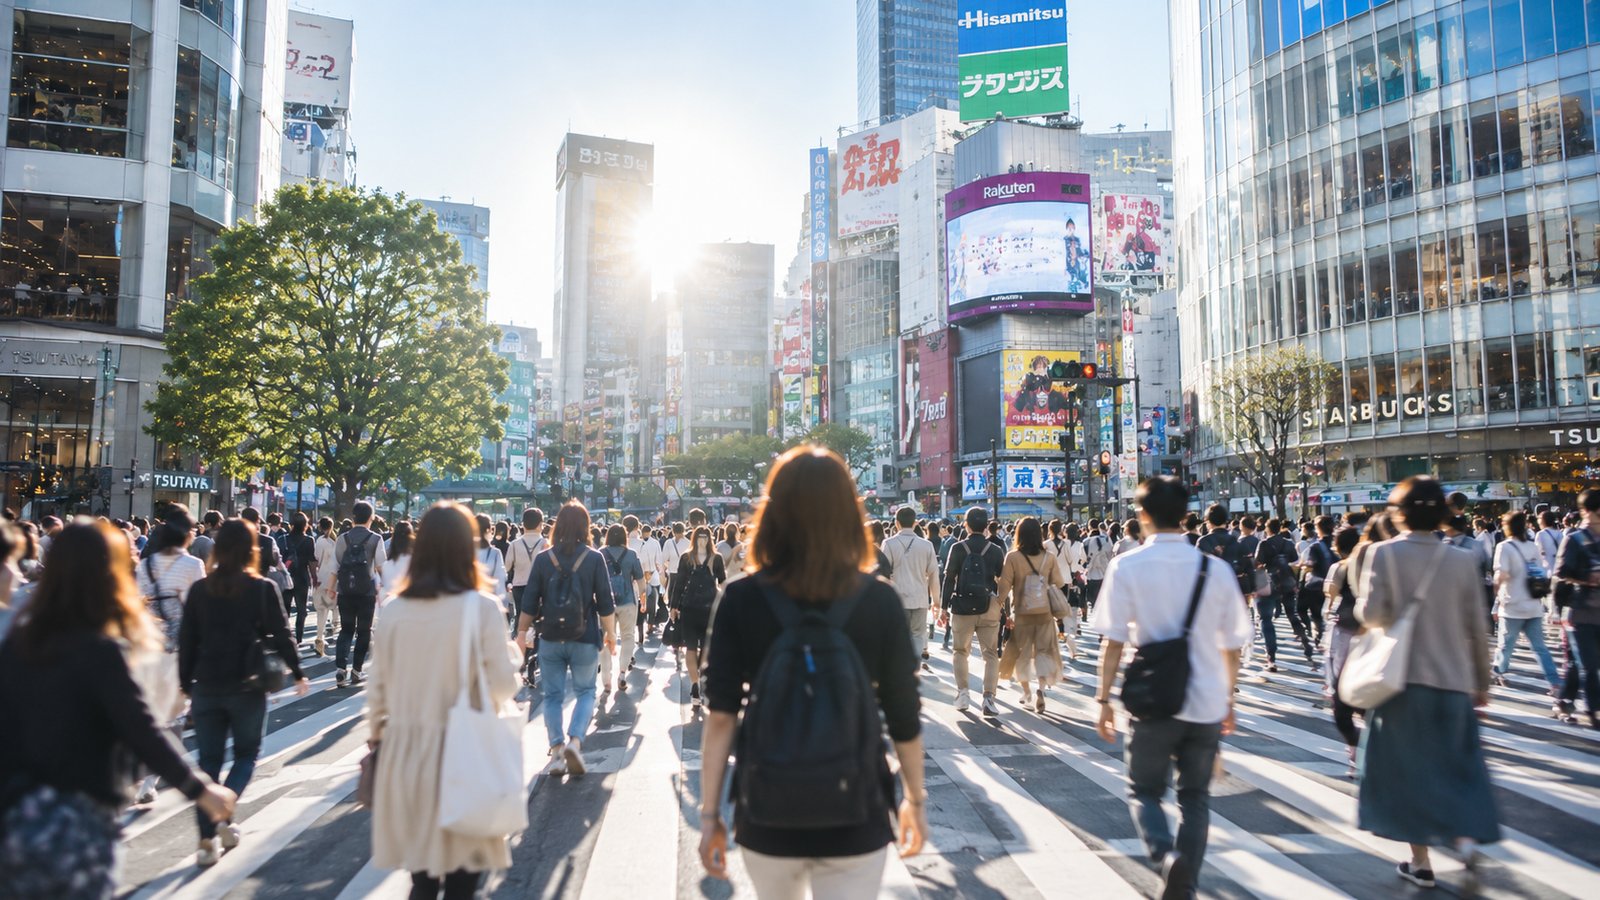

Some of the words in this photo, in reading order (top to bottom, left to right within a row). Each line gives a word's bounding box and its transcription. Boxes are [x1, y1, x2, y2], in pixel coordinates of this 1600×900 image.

[958, 8, 1064, 29] Hisamitsu
[983, 182, 1035, 199] Rakuten
[1302, 393, 1453, 428] STARBUCKS
[1549, 427, 1600, 445] TSU
